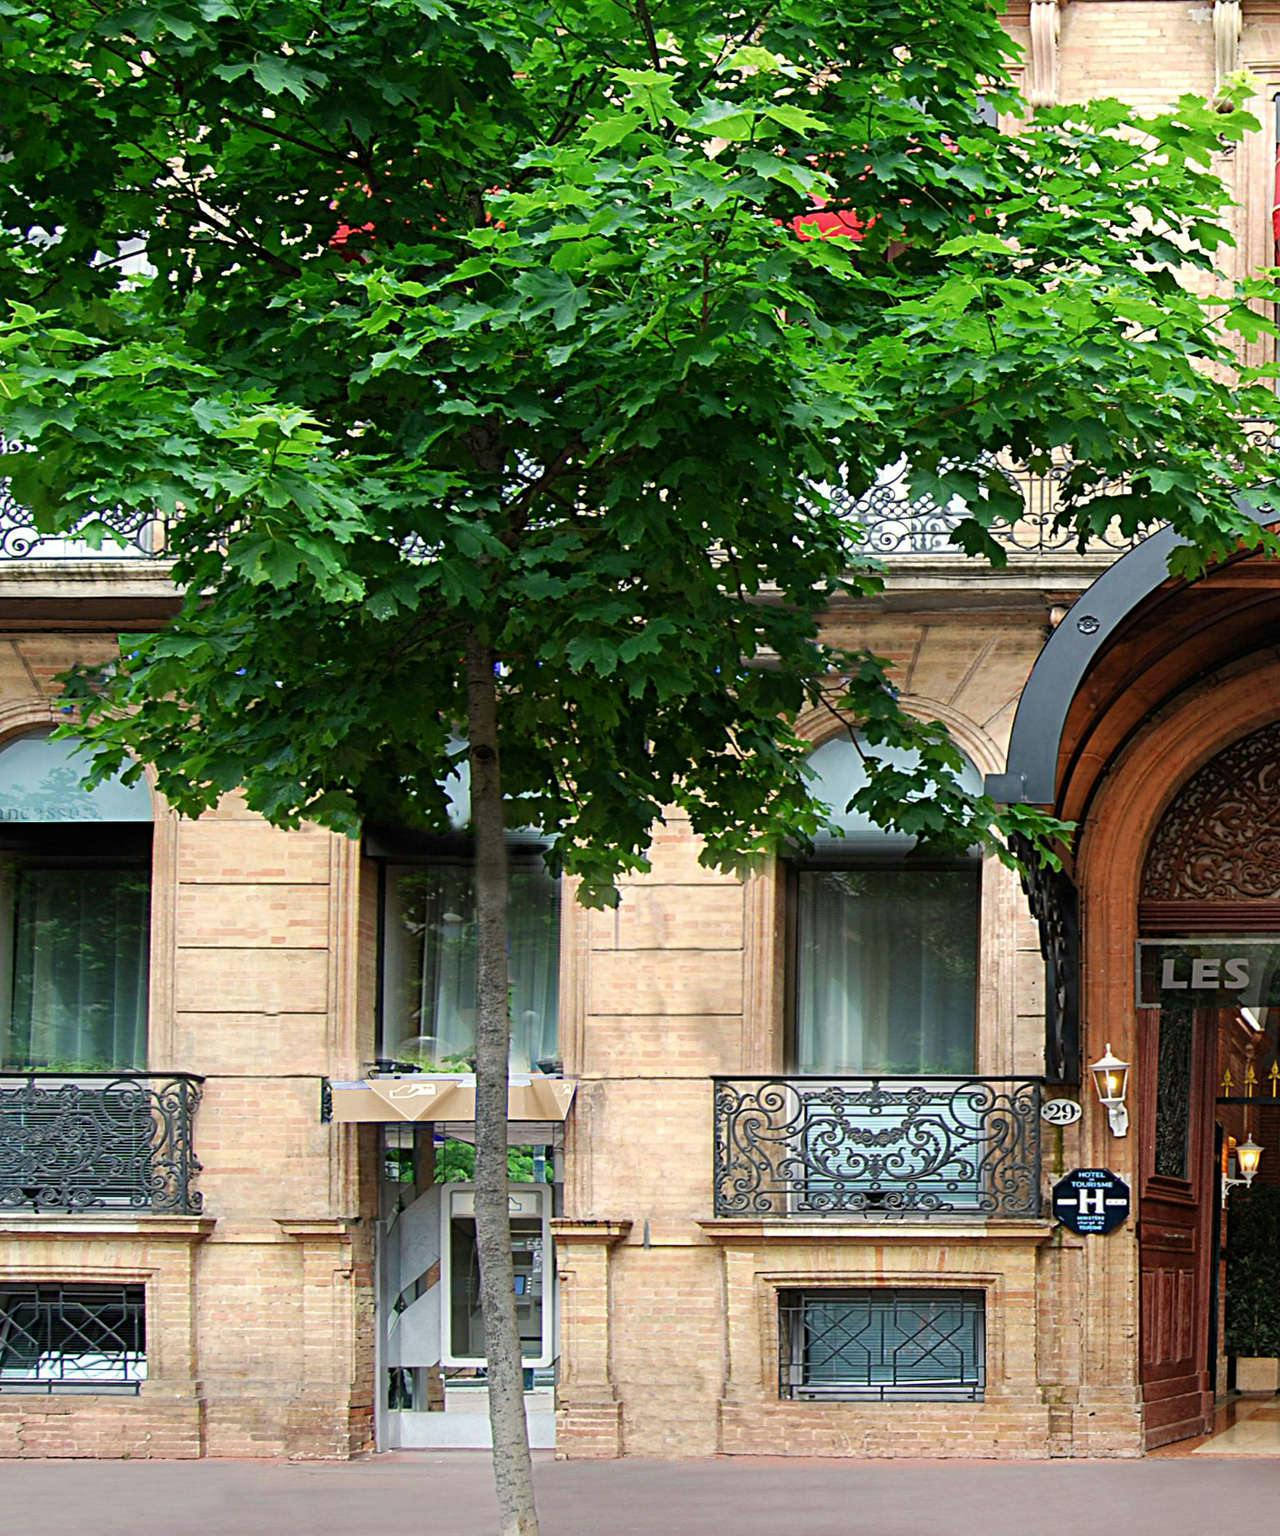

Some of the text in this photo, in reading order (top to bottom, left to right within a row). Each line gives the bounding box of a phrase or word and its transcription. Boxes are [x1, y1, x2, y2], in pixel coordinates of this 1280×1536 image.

[1161, 957, 1251, 990] LES
[1049, 1103, 1076, 1121] 29
[1079, 1188, 1105, 1214] H
